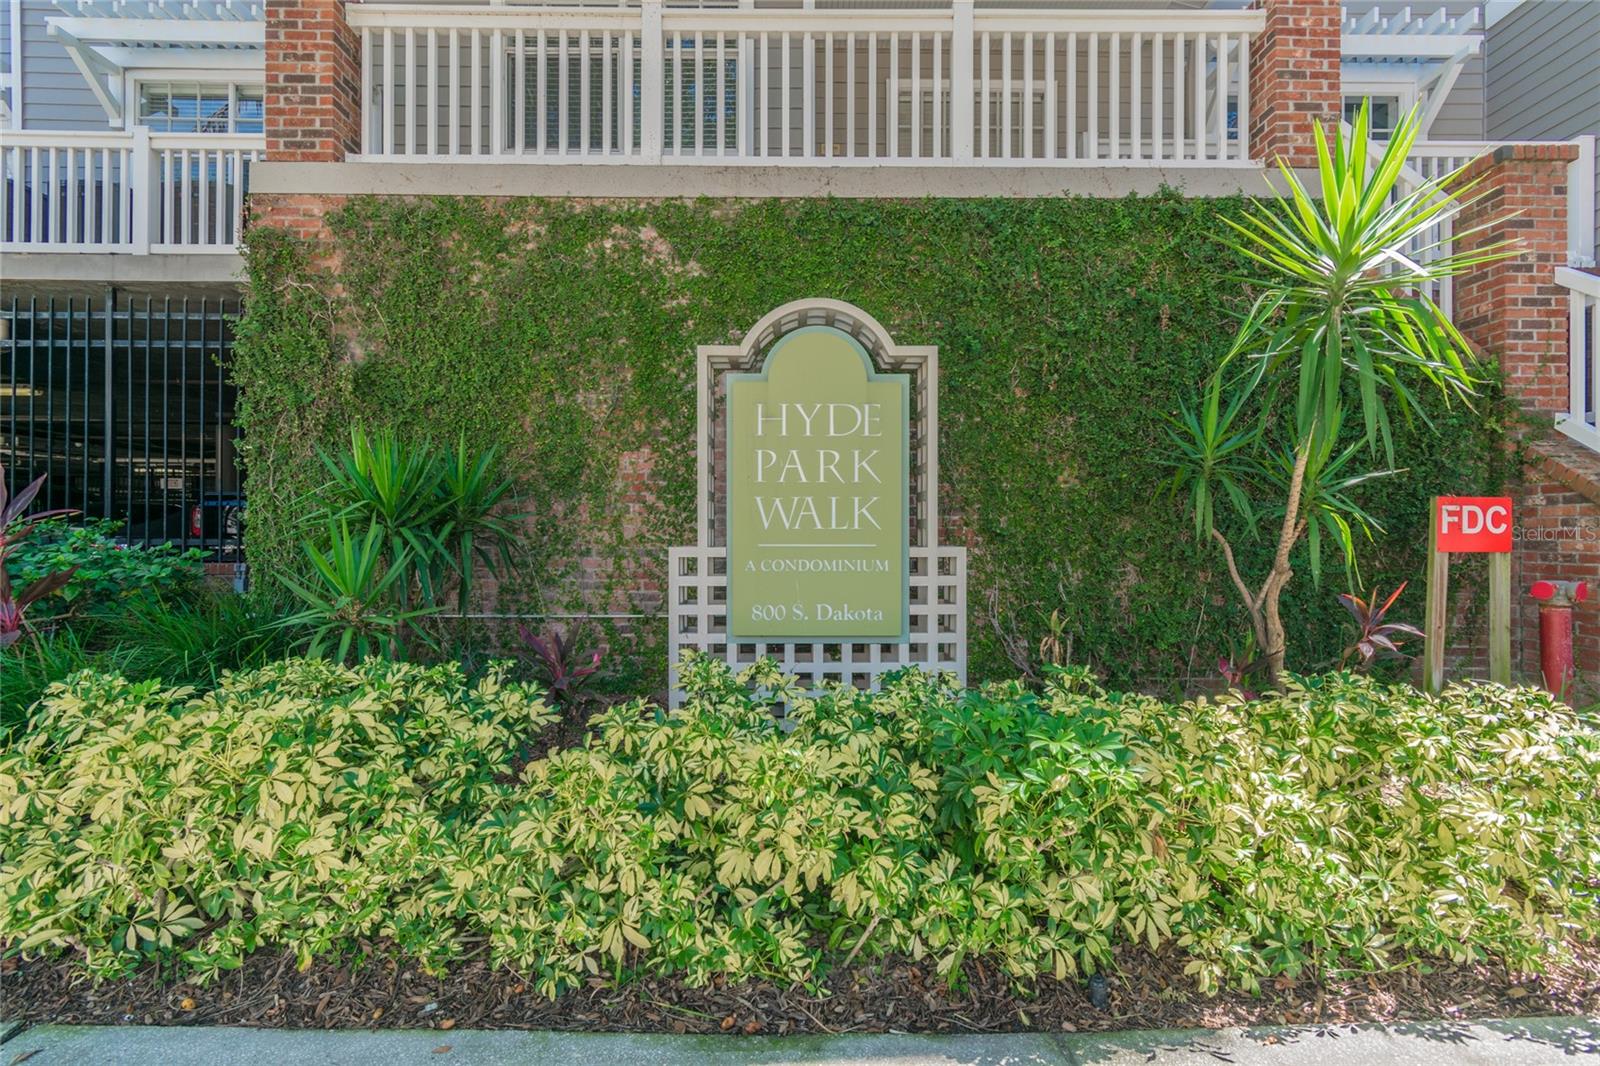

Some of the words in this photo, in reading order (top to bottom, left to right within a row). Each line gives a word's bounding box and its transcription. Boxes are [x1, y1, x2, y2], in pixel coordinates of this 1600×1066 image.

[756, 403, 882, 437] HYDE
[756, 449, 882, 484] PARK
[755, 496, 882, 530] WALK
[1441, 505, 1508, 534] FDC
[745, 560, 756, 572] A
[760, 559, 889, 573] CONDOMINIUM
[751, 604, 787, 621] 800
[792, 604, 809, 621] S.
[816, 603, 883, 621] Dakota
